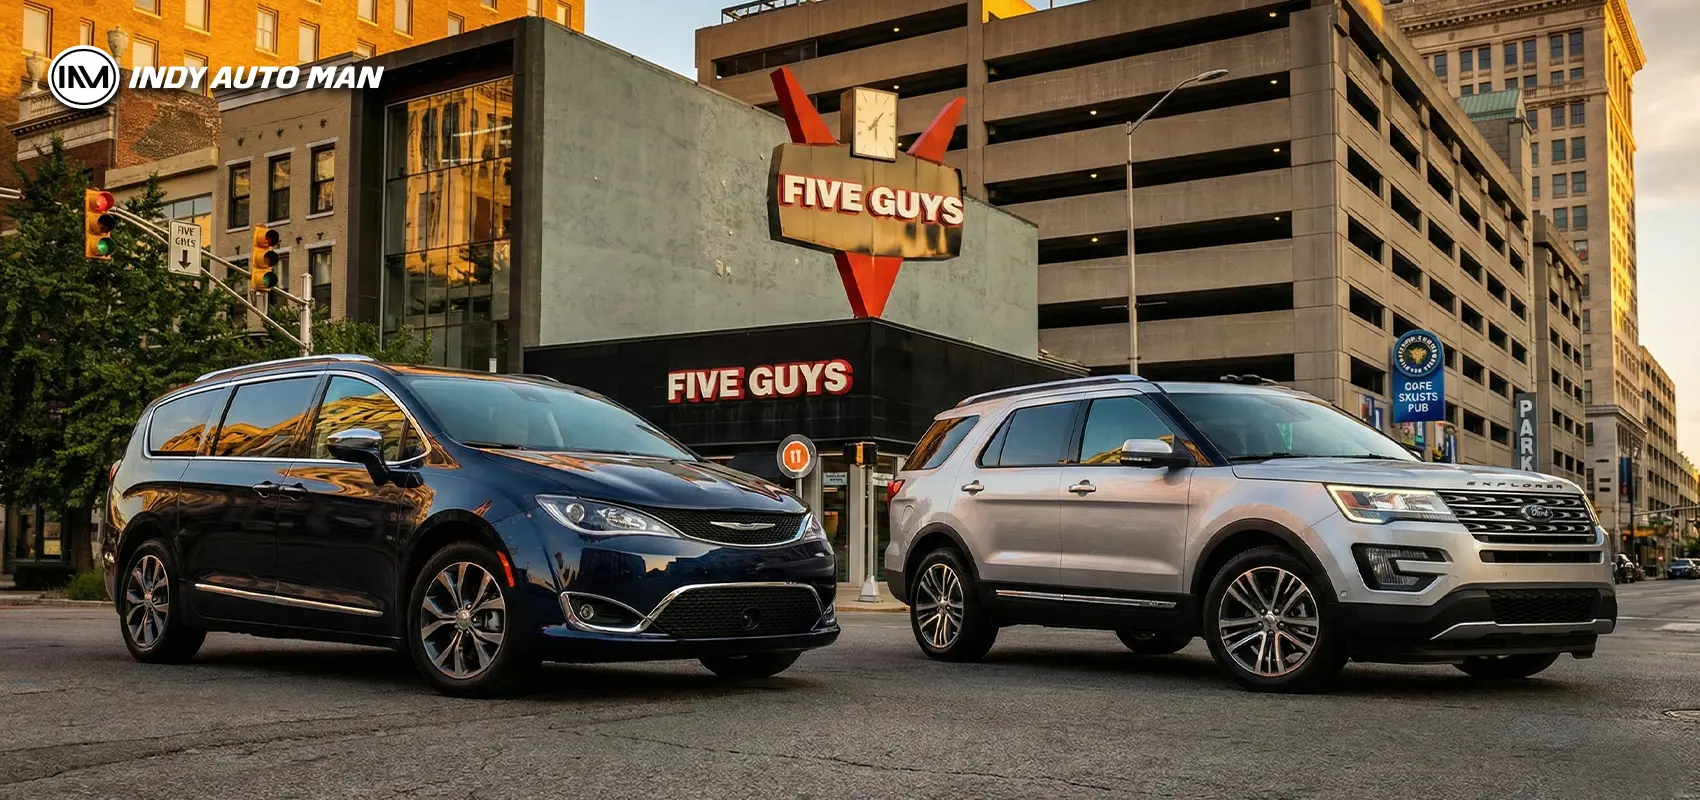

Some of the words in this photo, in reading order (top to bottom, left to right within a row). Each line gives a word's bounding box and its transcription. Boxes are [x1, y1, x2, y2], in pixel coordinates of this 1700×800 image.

[781, 174, 864, 213] FIVE
[870, 186, 964, 226] GUYS
[177, 225, 195, 236] FIVE
[668, 368, 743, 402] FIVE
[749, 360, 851, 398] GUYS
[1408, 403, 1429, 413] PUB
[1519, 399, 1534, 471] PARK
[1466, 481, 1563, 490] EXPLORER
